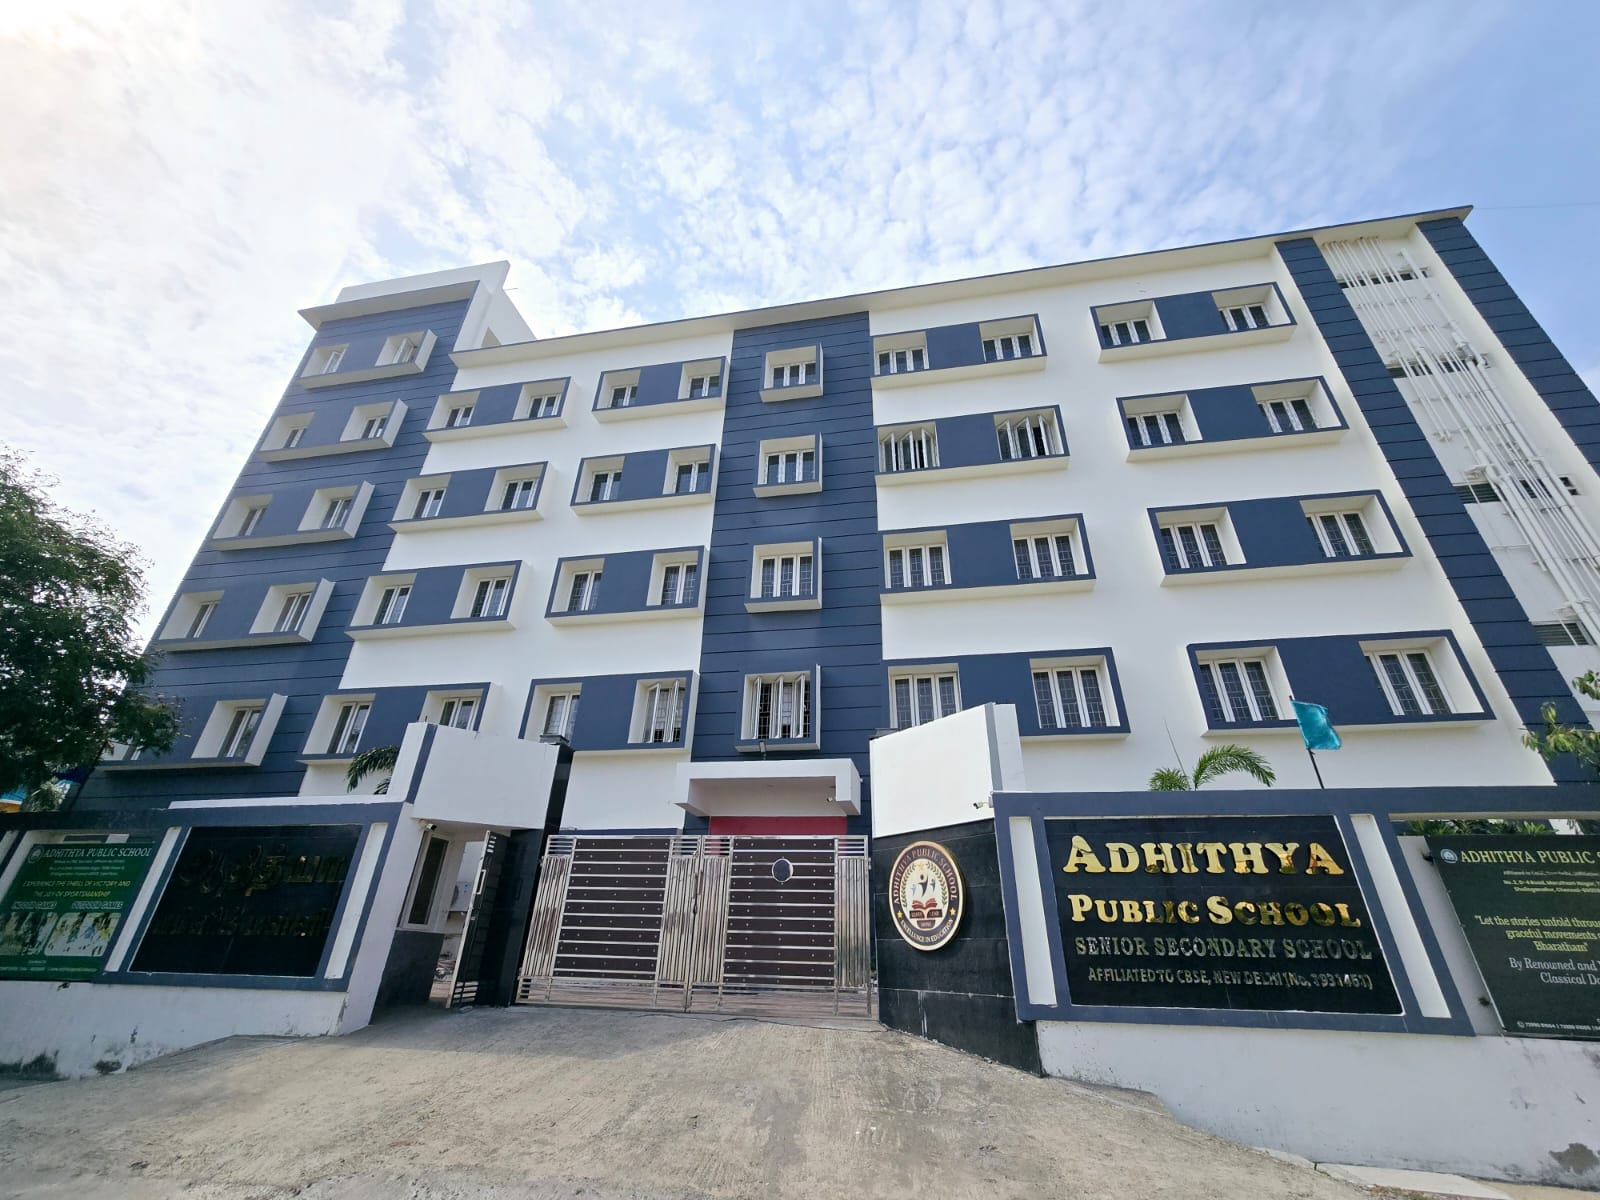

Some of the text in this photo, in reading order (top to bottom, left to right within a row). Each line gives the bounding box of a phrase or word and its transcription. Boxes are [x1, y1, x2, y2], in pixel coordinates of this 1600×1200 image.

[86, 847, 117, 857] PUBLIC
[117, 847, 152, 857] SCHOOL
[1062, 835, 1344, 875] ADHITHYA
[1461, 850, 1536, 864] ADHITHYA
[1539, 850, 1595, 865] PUBLIC
[912, 848, 938, 861] PUBLIC
[939, 859, 958, 902] SCHOOL
[1067, 894, 1361, 927] PUBLIC SCHOOL
[1494, 916, 1510, 926] the
[1510, 917, 1540, 926] stories
[1540, 917, 1572, 927] unfold
[1505, 928, 1543, 940] graceful
[1543, 931, 1597, 940] movements
[1075, 936, 1373, 960] SENIOR SECONDARY SCHOOL
[1508, 957, 1523, 972] By
[1523, 957, 1576, 970] Renowned
[1577, 959, 1598, 971] and
[1088, 966, 1155, 982] AFFILIATED
[1156, 969, 1174, 983] TO
[1176, 969, 1212, 986] CBSE,
[1213, 970, 1242, 985] NEW
[1243, 971, 1283, 986] DELHI
[1539, 972, 1587, 985] Classical
